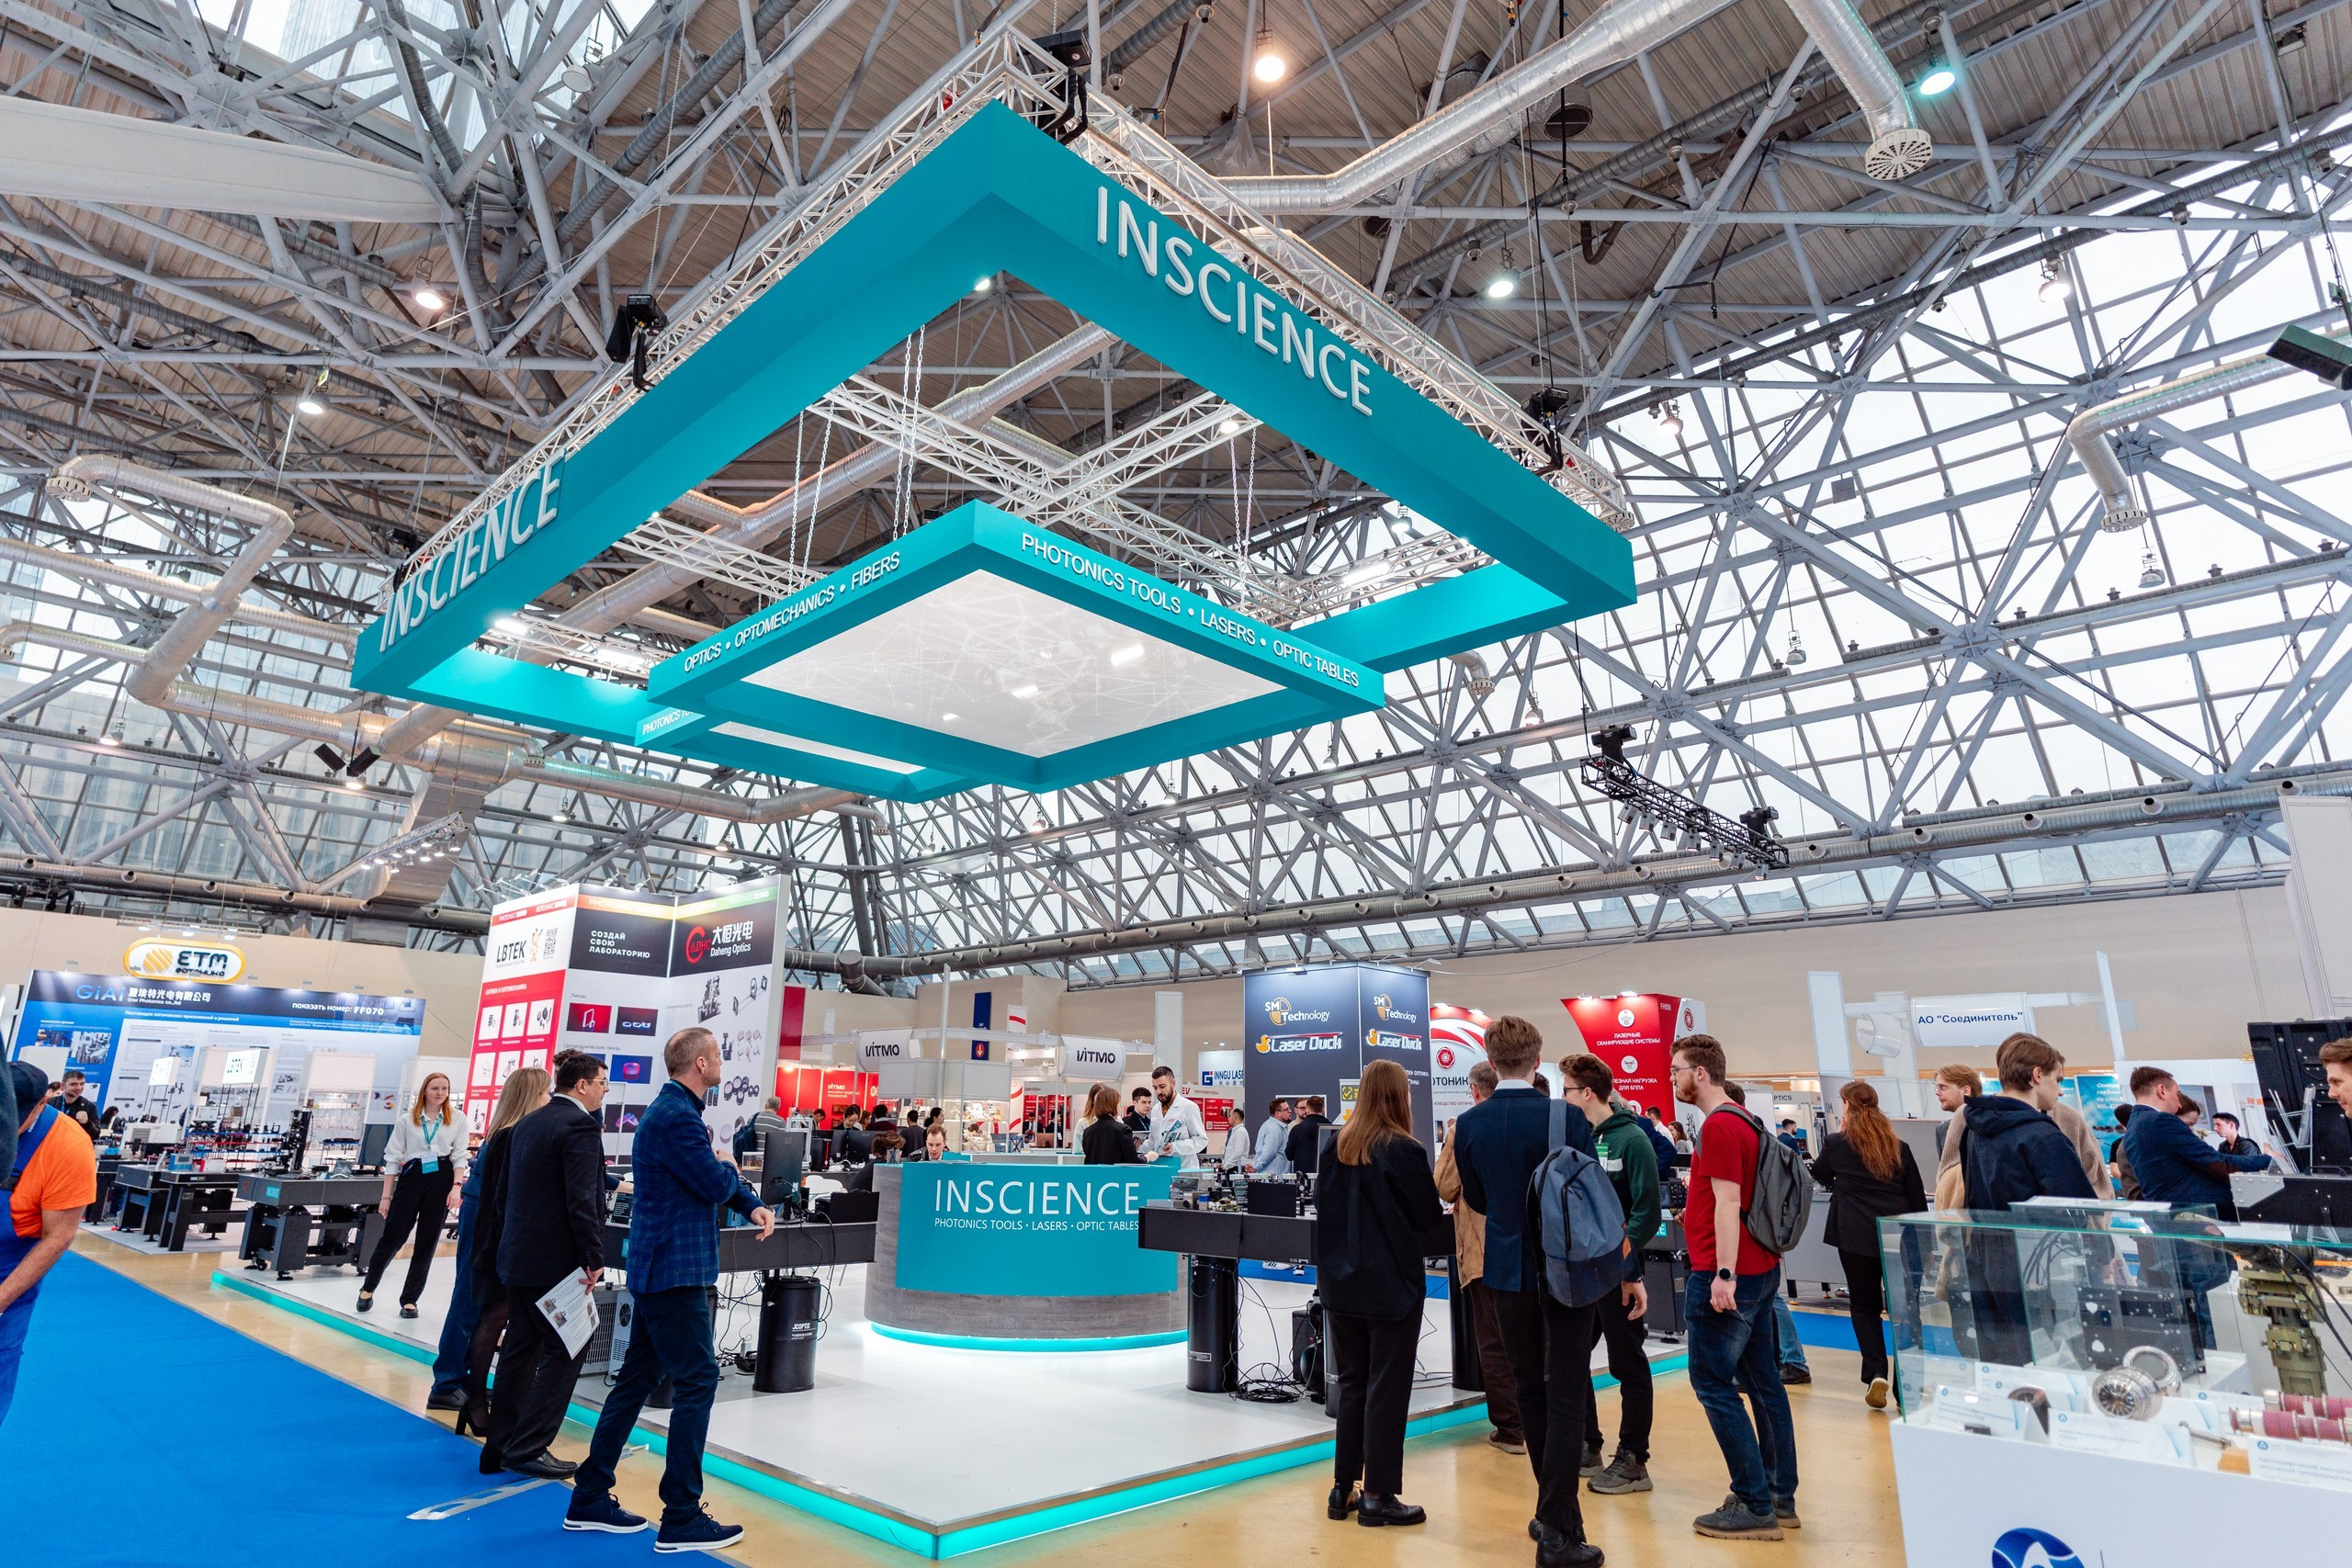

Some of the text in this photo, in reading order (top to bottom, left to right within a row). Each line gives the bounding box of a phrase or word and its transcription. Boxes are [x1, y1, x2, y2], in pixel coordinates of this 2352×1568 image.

[1097, 186, 1373, 416] INSCIENCE
[380, 448, 565, 653] INSCIENCE
[684, 551, 900, 672] OPTICS OPTOMECHANICS FIBERS
[1022, 533, 1360, 687] PHOTONICS TOOLS LASERS OPTIC TABLES
[643, 710, 681, 736] PHOTONICS
[591, 930, 626, 940] СОЗДАЙ
[711, 920, 754, 945] 大恒光电
[590, 938, 616, 947] СВОЮ
[710, 942, 752, 957] Daheng Optics
[496, 941, 526, 963] LBTEK
[589, 946, 650, 959] ЛАБОРАТОРИЮ
[177, 951, 228, 969] ETM
[1265, 1001, 1280, 1011] SM
[1374, 996, 1385, 1006] SM
[292, 1002, 384, 1016] показать номер: FF070
[1281, 1010, 1330, 1022] Technology
[1385, 1009, 1418, 1023] Technology
[1918, 1012, 2023, 1024] АО "Соединитель"
[1271, 1035, 1342, 1053] Laser Duck
[1376, 1032, 1422, 1051] Laser Duck
[1215, 1069, 1243, 1080] INNGU LASE
[1432, 1077, 1469, 1086] ТОНИК
[935, 1179, 1140, 1215] INSCIENCE
[934, 1218, 1139, 1231] PHOTONICS TOOLS LASERS OPTIC TABLES
